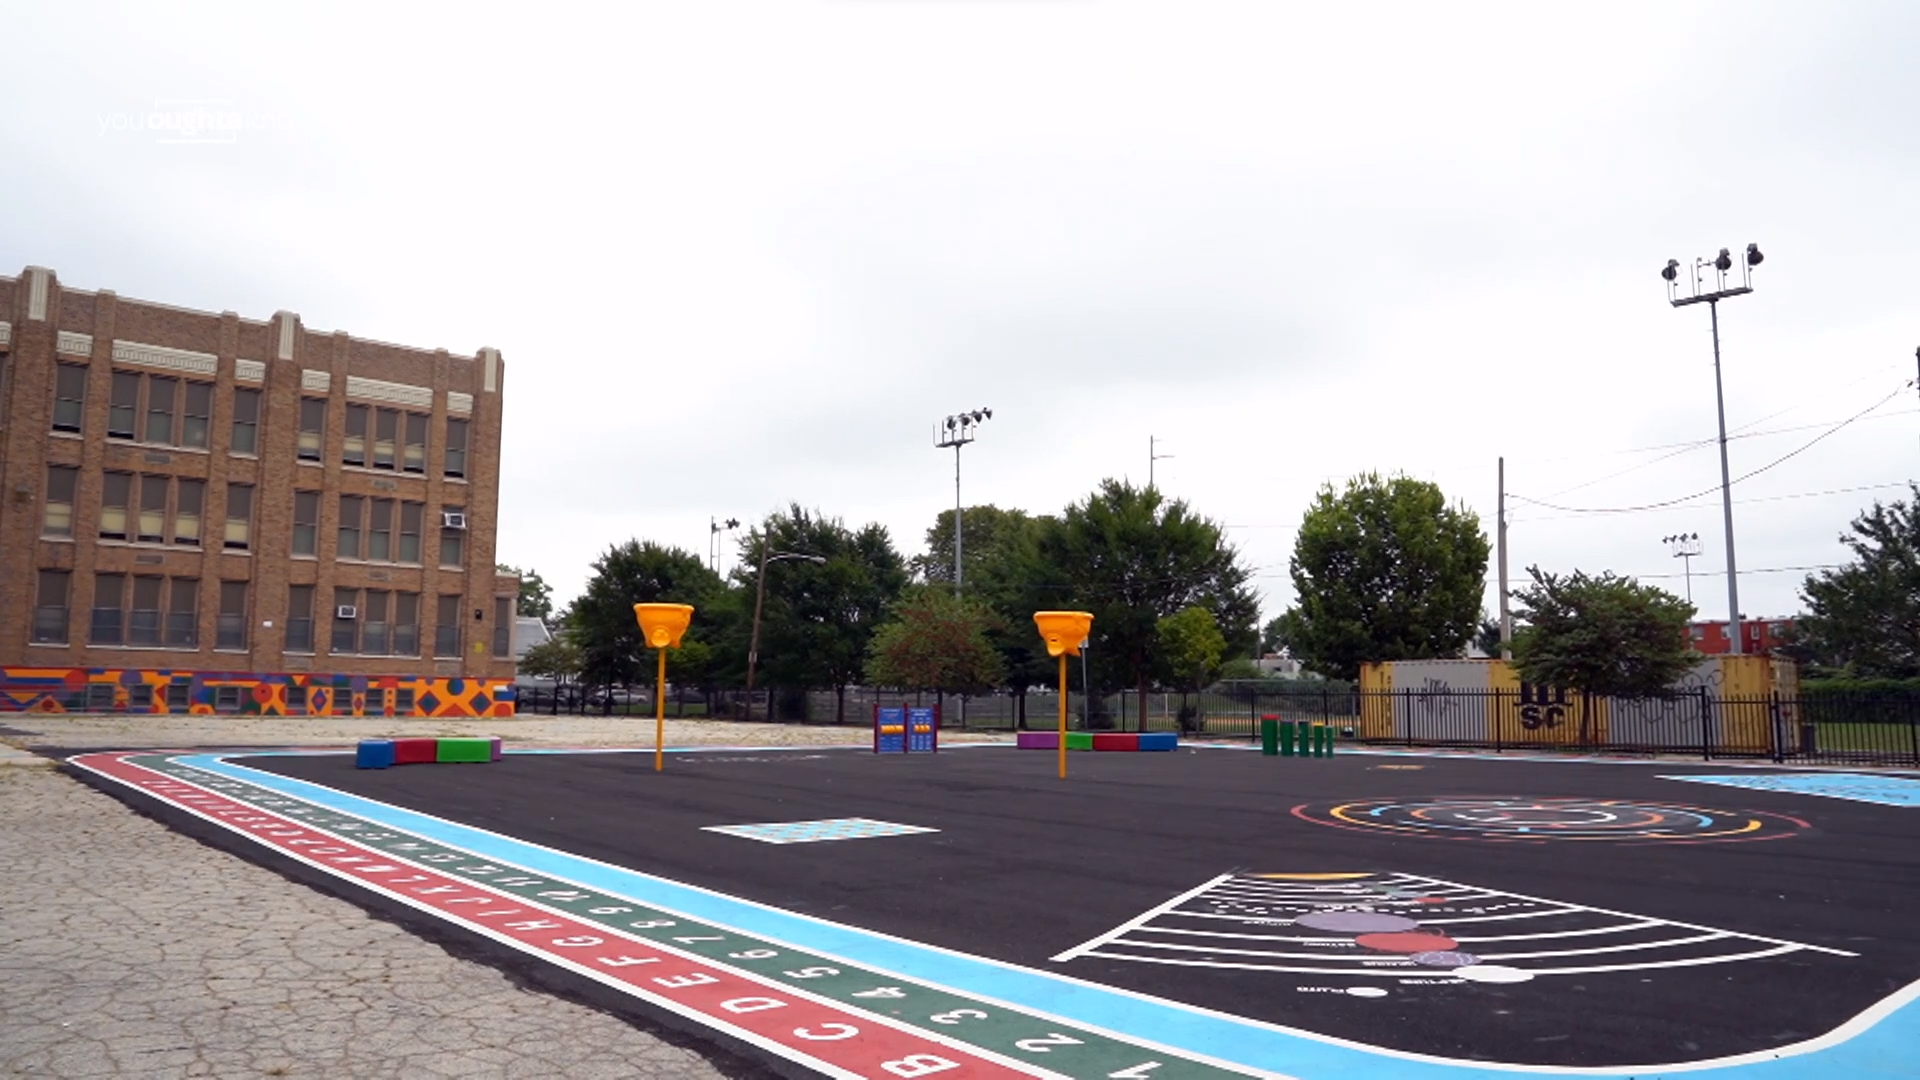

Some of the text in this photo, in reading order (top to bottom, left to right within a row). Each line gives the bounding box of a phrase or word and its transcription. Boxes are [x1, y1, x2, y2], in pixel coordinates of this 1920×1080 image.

[536, 891, 590, 902] 10
[588, 906, 633, 915] 9
[503, 919, 563, 931] H
[630, 919, 676, 929] 8
[551, 934, 604, 947] G
[672, 935, 726, 945] 7
[728, 949, 778, 960] 6
[596, 955, 662, 967] F
[783, 966, 840, 979] 5
[652, 972, 720, 988] E
[851, 986, 907, 998] 4
[720, 996, 788, 1014] D
[929, 1008, 988, 1025] 3
[792, 1022, 860, 1041] C
[1014, 1032, 1087, 1053] 2
[880, 1053, 962, 1079] B
